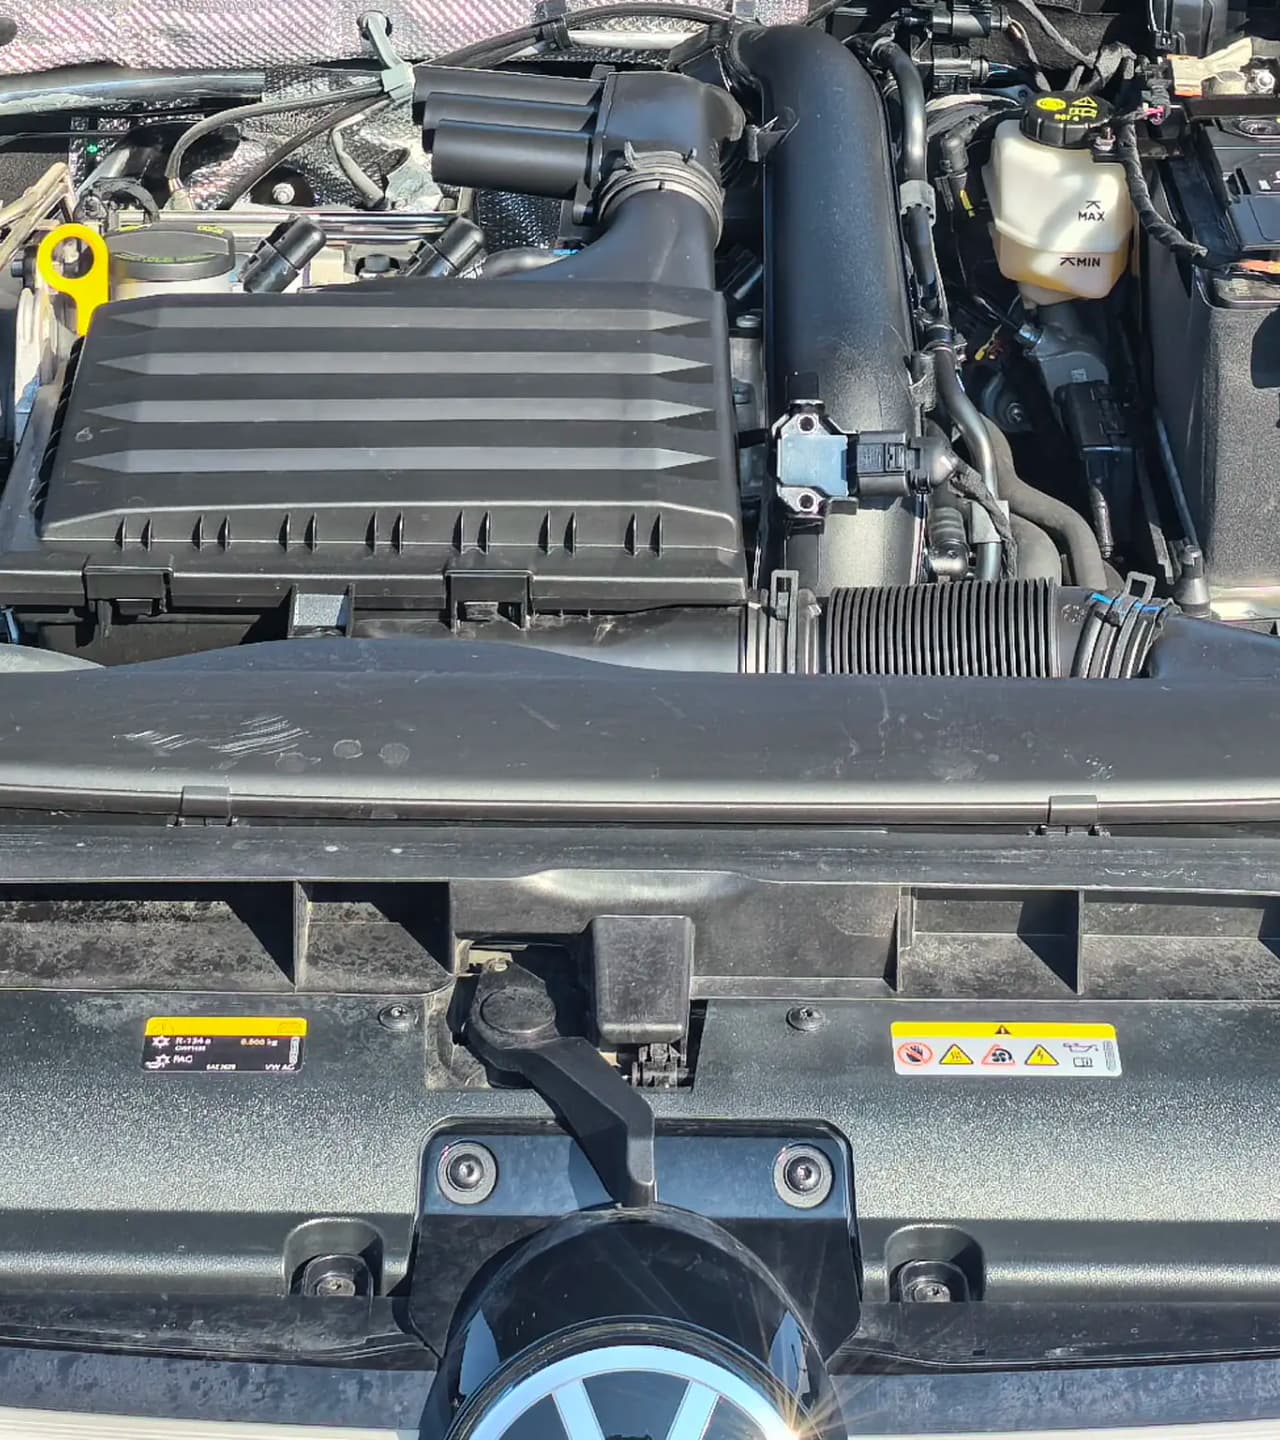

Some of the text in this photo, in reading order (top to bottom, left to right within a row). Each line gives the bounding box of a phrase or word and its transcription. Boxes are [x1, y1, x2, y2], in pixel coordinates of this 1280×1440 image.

[1078, 211, 1105, 222] MAX
[1076, 257, 1101, 267] MIN
[264, 1063, 280, 1071] VW
